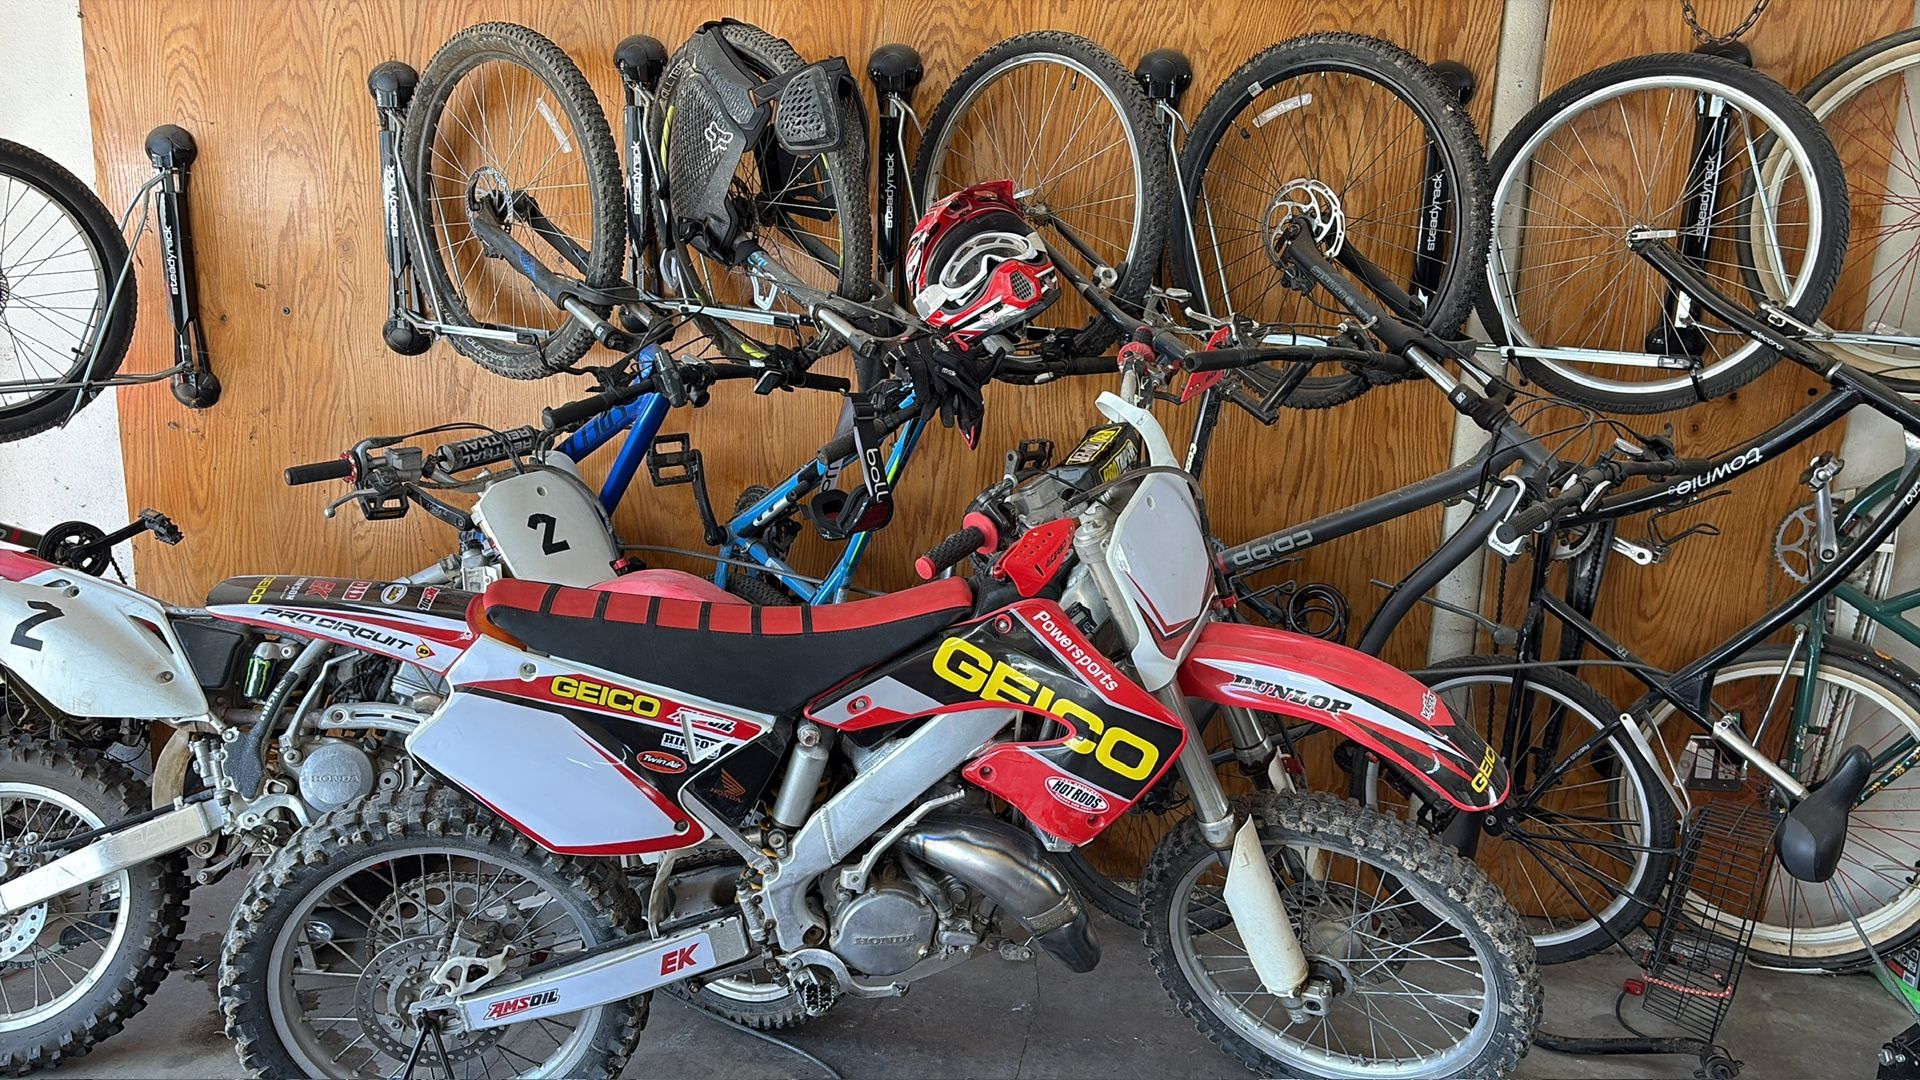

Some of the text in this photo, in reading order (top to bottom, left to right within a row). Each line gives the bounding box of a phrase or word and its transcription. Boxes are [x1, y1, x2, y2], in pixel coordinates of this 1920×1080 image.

[631, 141, 644, 214] steadyrack
[885, 153, 897, 229] steadyrack
[386, 165, 400, 237] steadyrack
[1427, 174, 1443, 251] steadyrack
[163, 225, 179, 295] steadyrack
[466, 336, 507, 361] GROUND
[1750, 330, 1784, 350] electra
[462, 437, 533, 464] RETHAL
[1676, 448, 1763, 492] townie
[866, 448, 889, 502] boll
[527, 513, 571, 555] 2
[305, 580, 337, 600] EK
[343, 581, 372, 601] DID
[10, 600, 65, 652] 2
[260, 608, 413, 650] PRO CIRCUIT
[1032, 610, 1119, 692] Powersports
[551, 675, 661, 718] GEICO
[932, 636, 1160, 781] GEICO
[1232, 674, 1353, 714] DUNLOP
[311, 775, 360, 783] HONDA
[643, 754, 682, 770] Twin Air
[710, 787, 743, 803] HONDA
[1052, 780, 1075, 798] HOT
[1071, 786, 1103, 809] RODS
[660, 943, 699, 976] EK
[854, 933, 919, 945] HONDA
[486, 989, 558, 1018] AMSOIL
